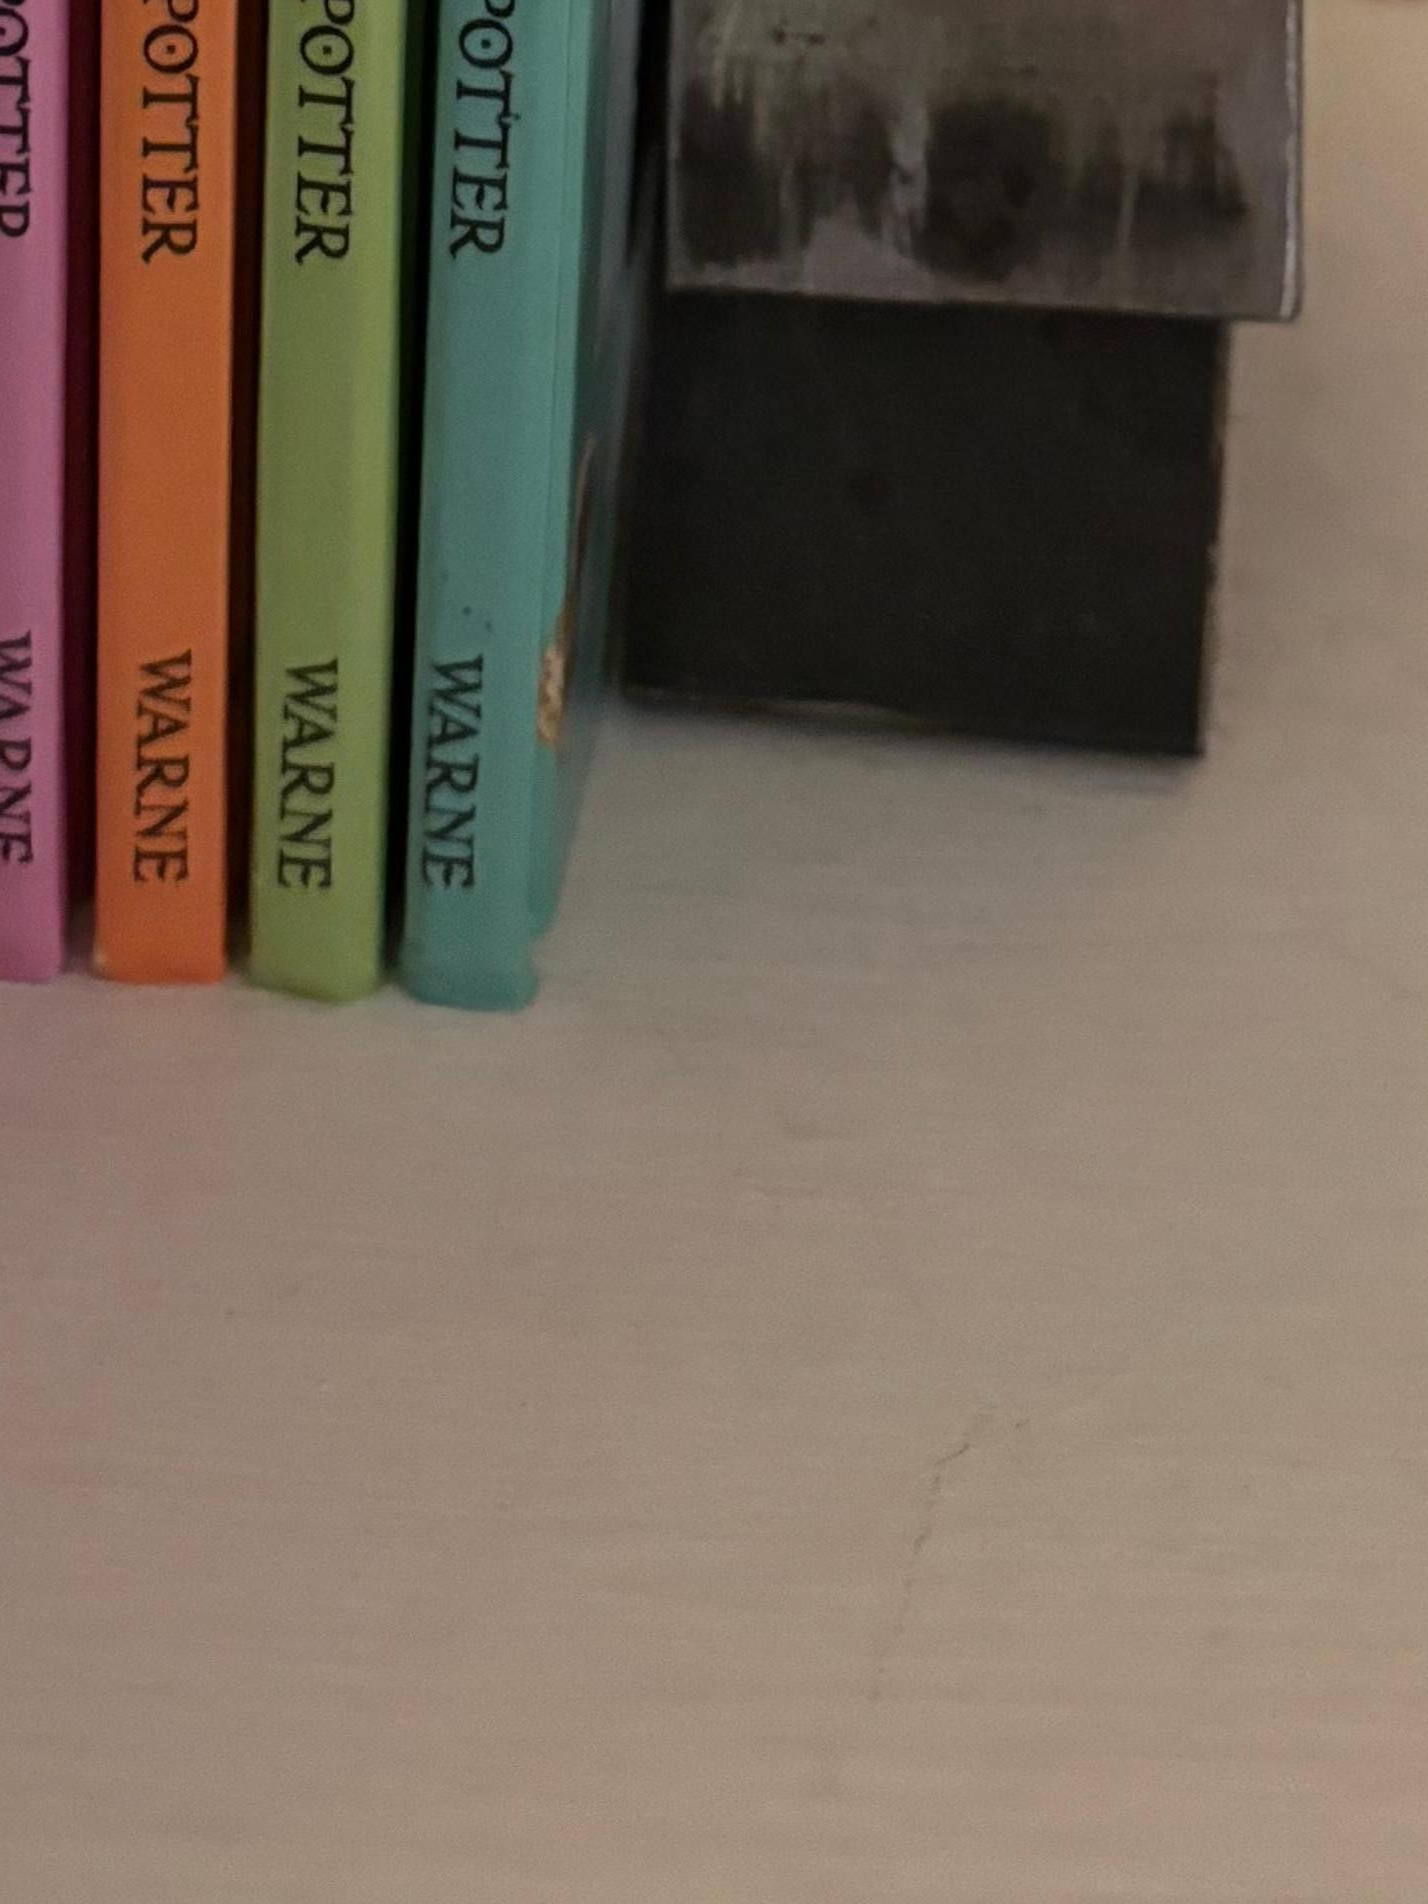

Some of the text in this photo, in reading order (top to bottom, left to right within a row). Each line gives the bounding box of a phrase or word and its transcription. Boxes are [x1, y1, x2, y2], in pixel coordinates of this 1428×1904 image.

[133, 649, 192, 882] WARNE
[276, 657, 338, 890] WARNE
[421, 654, 484, 889] WARNE
